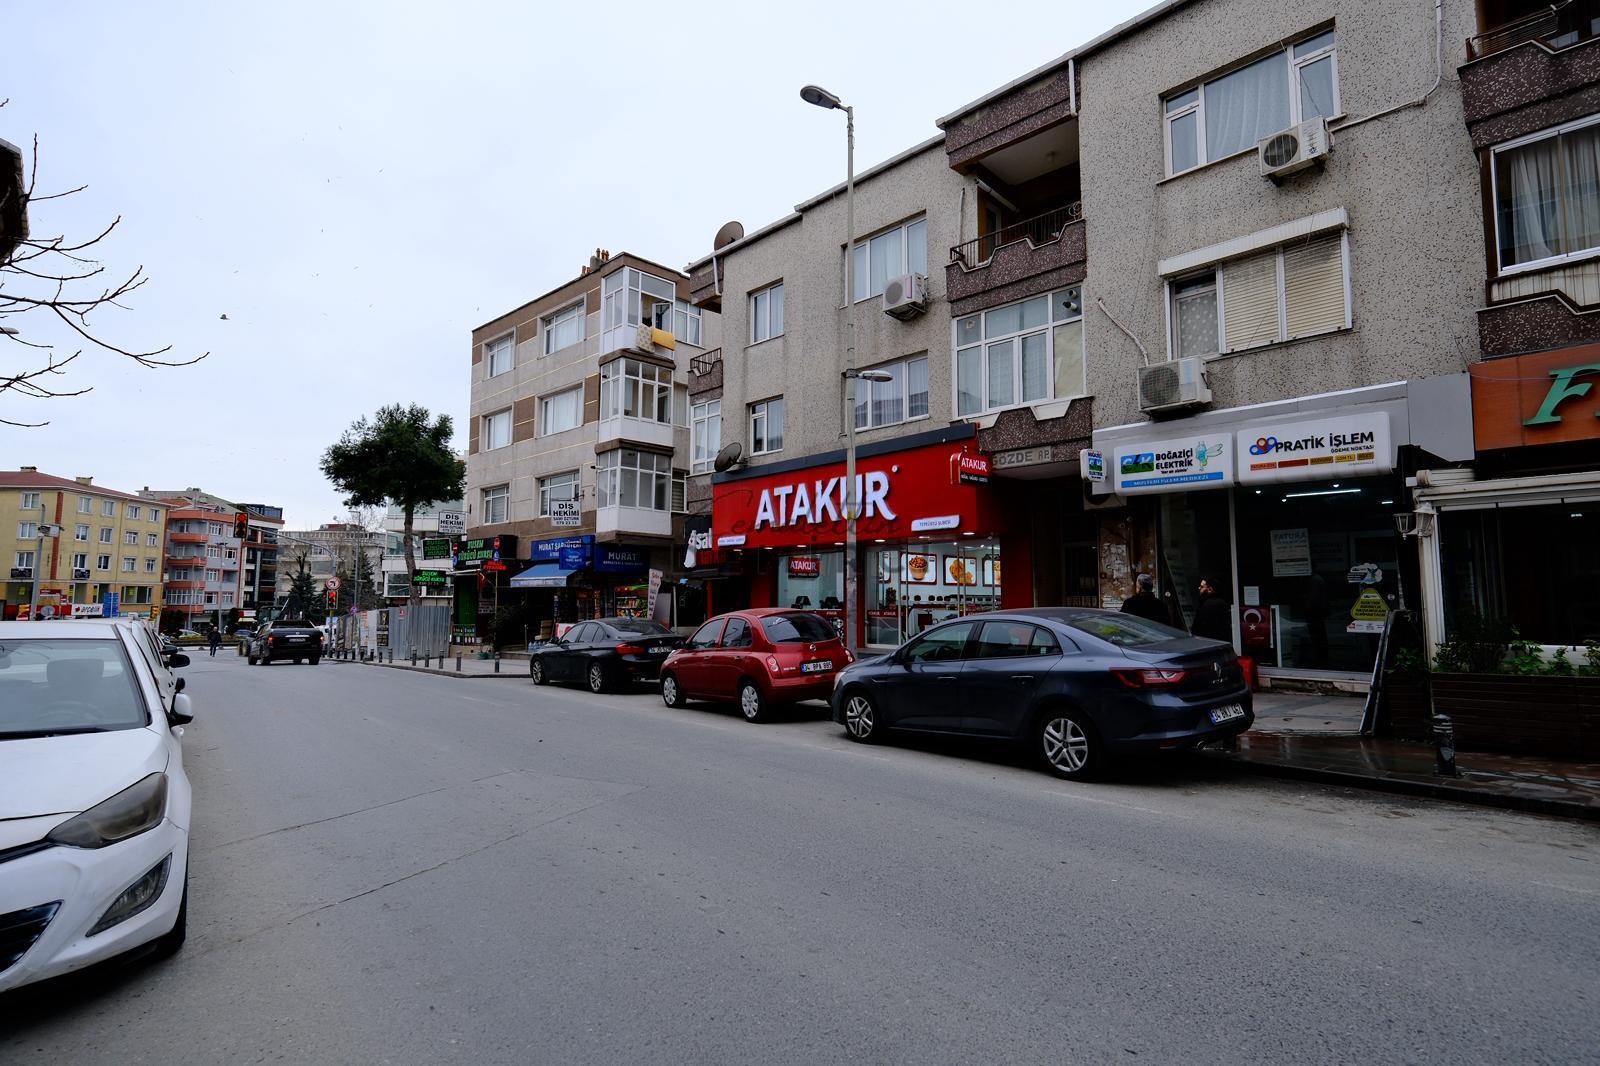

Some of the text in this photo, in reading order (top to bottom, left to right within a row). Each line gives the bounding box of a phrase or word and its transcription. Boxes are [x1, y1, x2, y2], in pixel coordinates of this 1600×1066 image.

[1275, 431, 1374, 452] PRATİK İŞLEM
[1155, 448, 1193, 461] BOĞAZİÇİ
[961, 458, 987, 472] ATAKUR
[1155, 459, 1193, 469] ELEKTRİK
[755, 470, 897, 530] ATAKUR
[539, 542, 554, 552] MURAT
[608, 552, 636, 561] MURAT
[790, 560, 817, 570] ATAKUR
